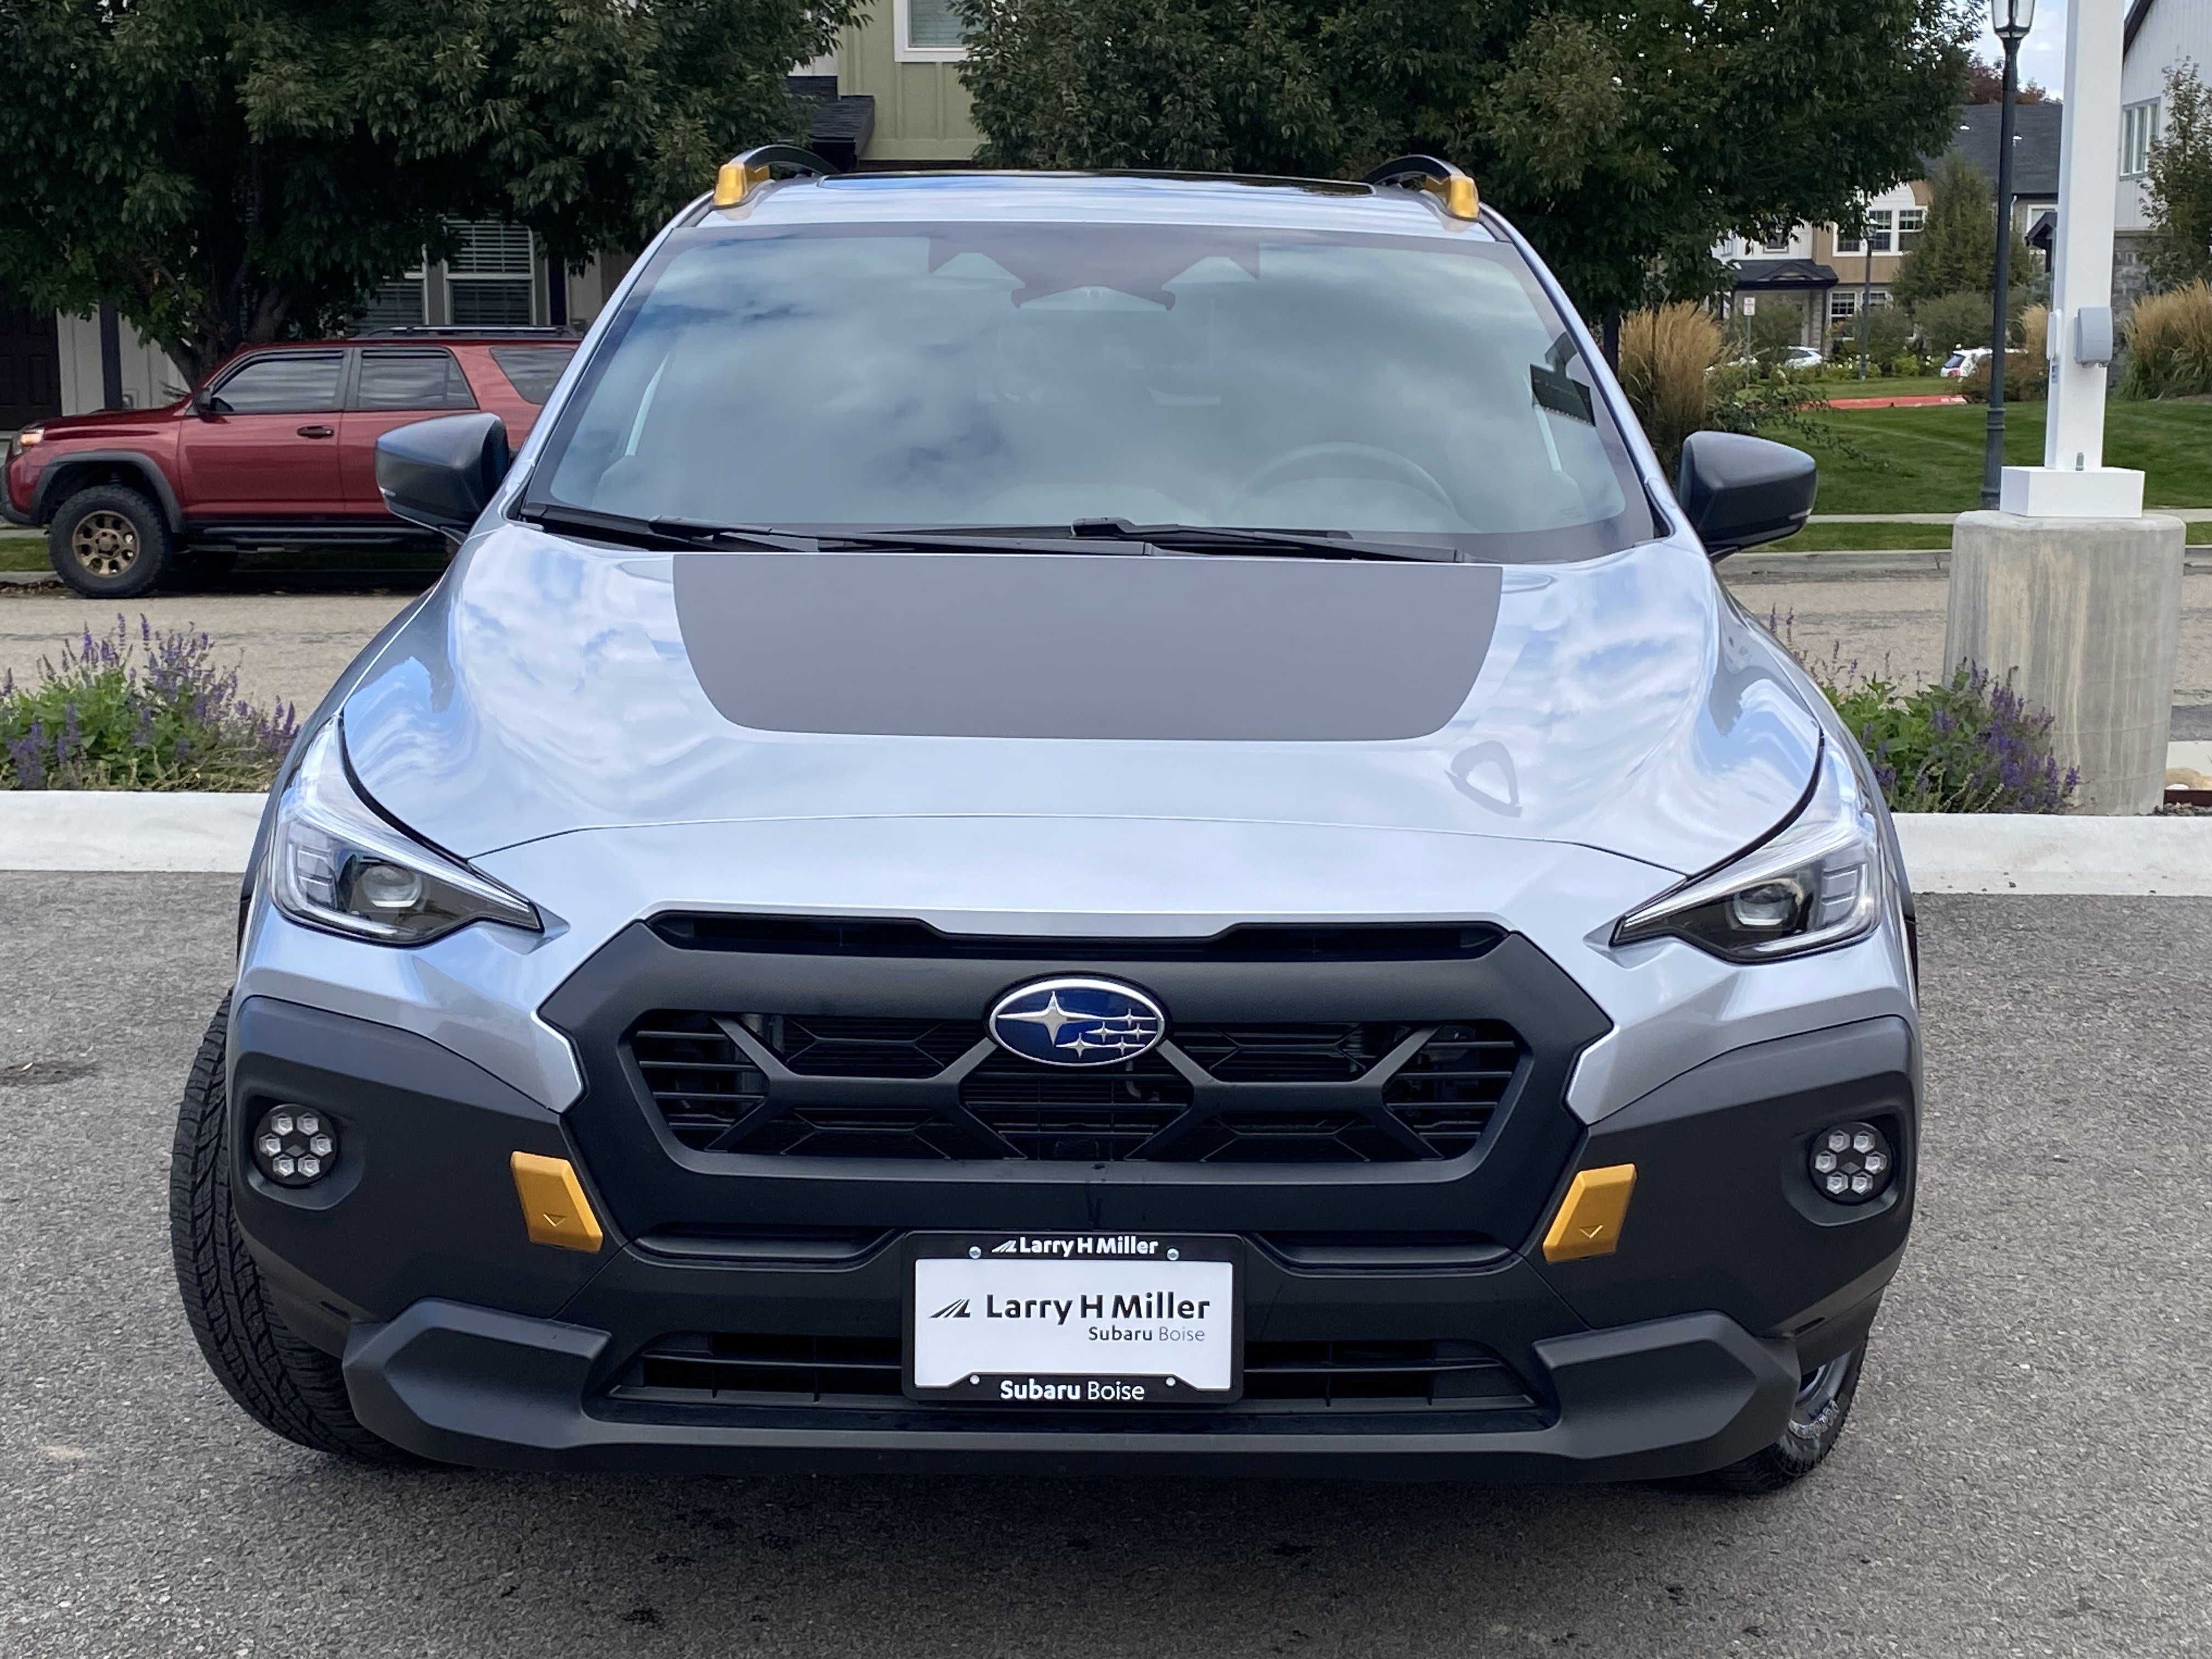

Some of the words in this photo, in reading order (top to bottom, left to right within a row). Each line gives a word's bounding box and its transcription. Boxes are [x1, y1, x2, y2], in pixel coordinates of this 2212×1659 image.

[1019, 1237, 1074, 1257] Larry
[1077, 1237, 1093, 1254] H
[1096, 1235, 1159, 1254] Miller
[986, 1294, 1074, 1325] Larry
[1080, 1294, 1103, 1318] H
[1111, 1291, 1210, 1319] Miller
[1088, 1325, 1153, 1341] Subaru
[1159, 1326, 1205, 1341] Boise
[1000, 1378, 1081, 1400] Subaru
[1087, 1380, 1146, 1401] Boise
